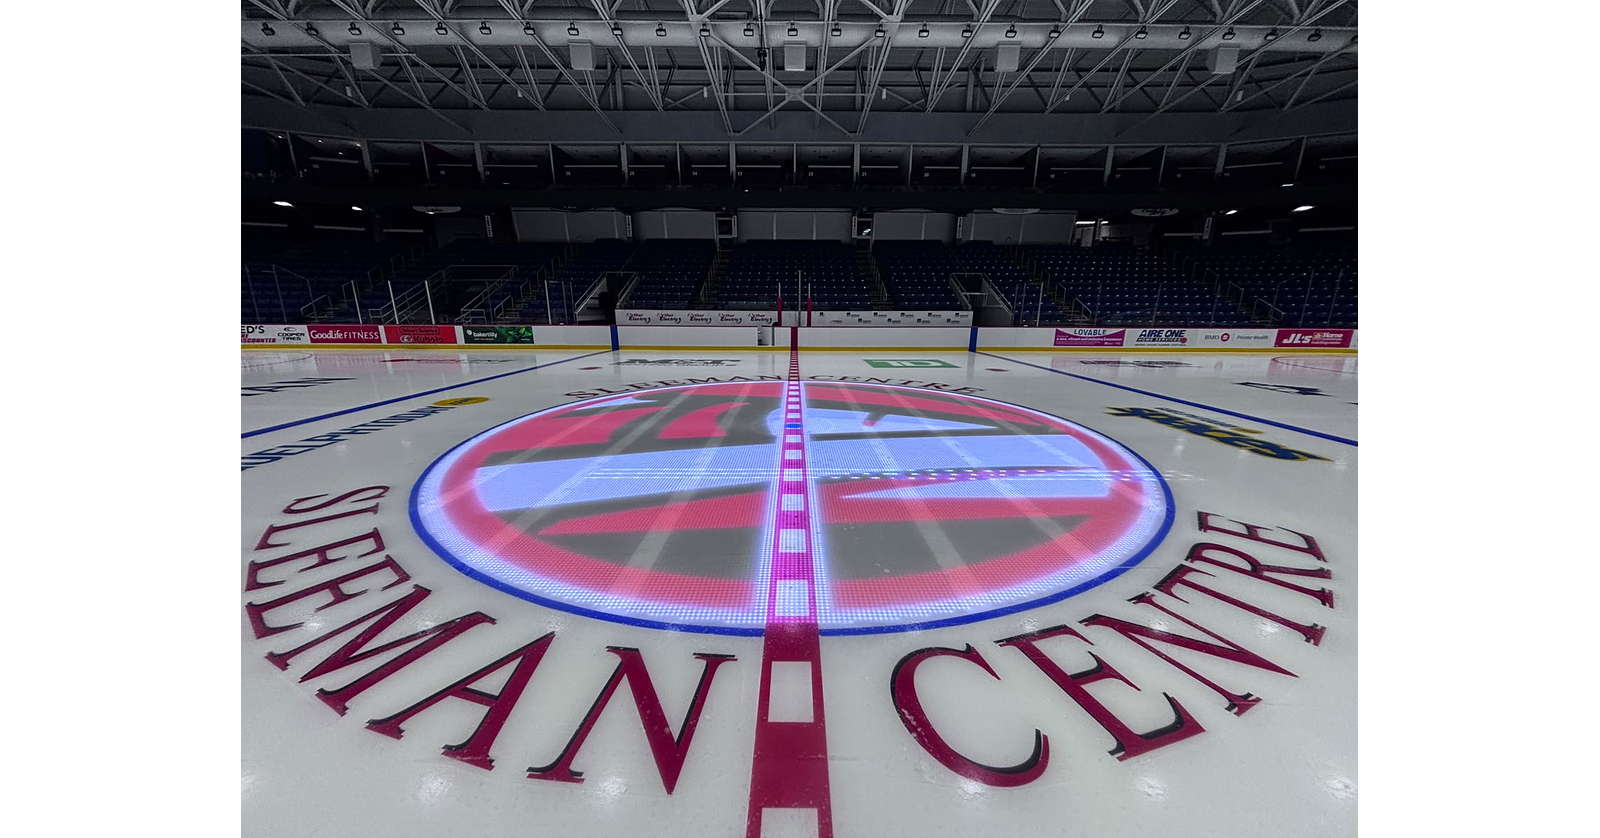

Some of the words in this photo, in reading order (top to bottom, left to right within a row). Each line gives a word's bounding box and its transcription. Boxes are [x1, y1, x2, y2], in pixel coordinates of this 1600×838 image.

[310, 330, 343, 340] GoodLife
[344, 331, 379, 340] FITNESS
[1139, 329, 1164, 338] AIRE
[1165, 329, 1187, 338] ONE
[564, 375, 784, 399] SLEEMAN
[808, 374, 987, 394] CENTRE
[241, 405, 457, 472] UELPHTODAY
[244, 485, 738, 795] SLEEMAN
[890, 510, 1335, 787] CENTRE
